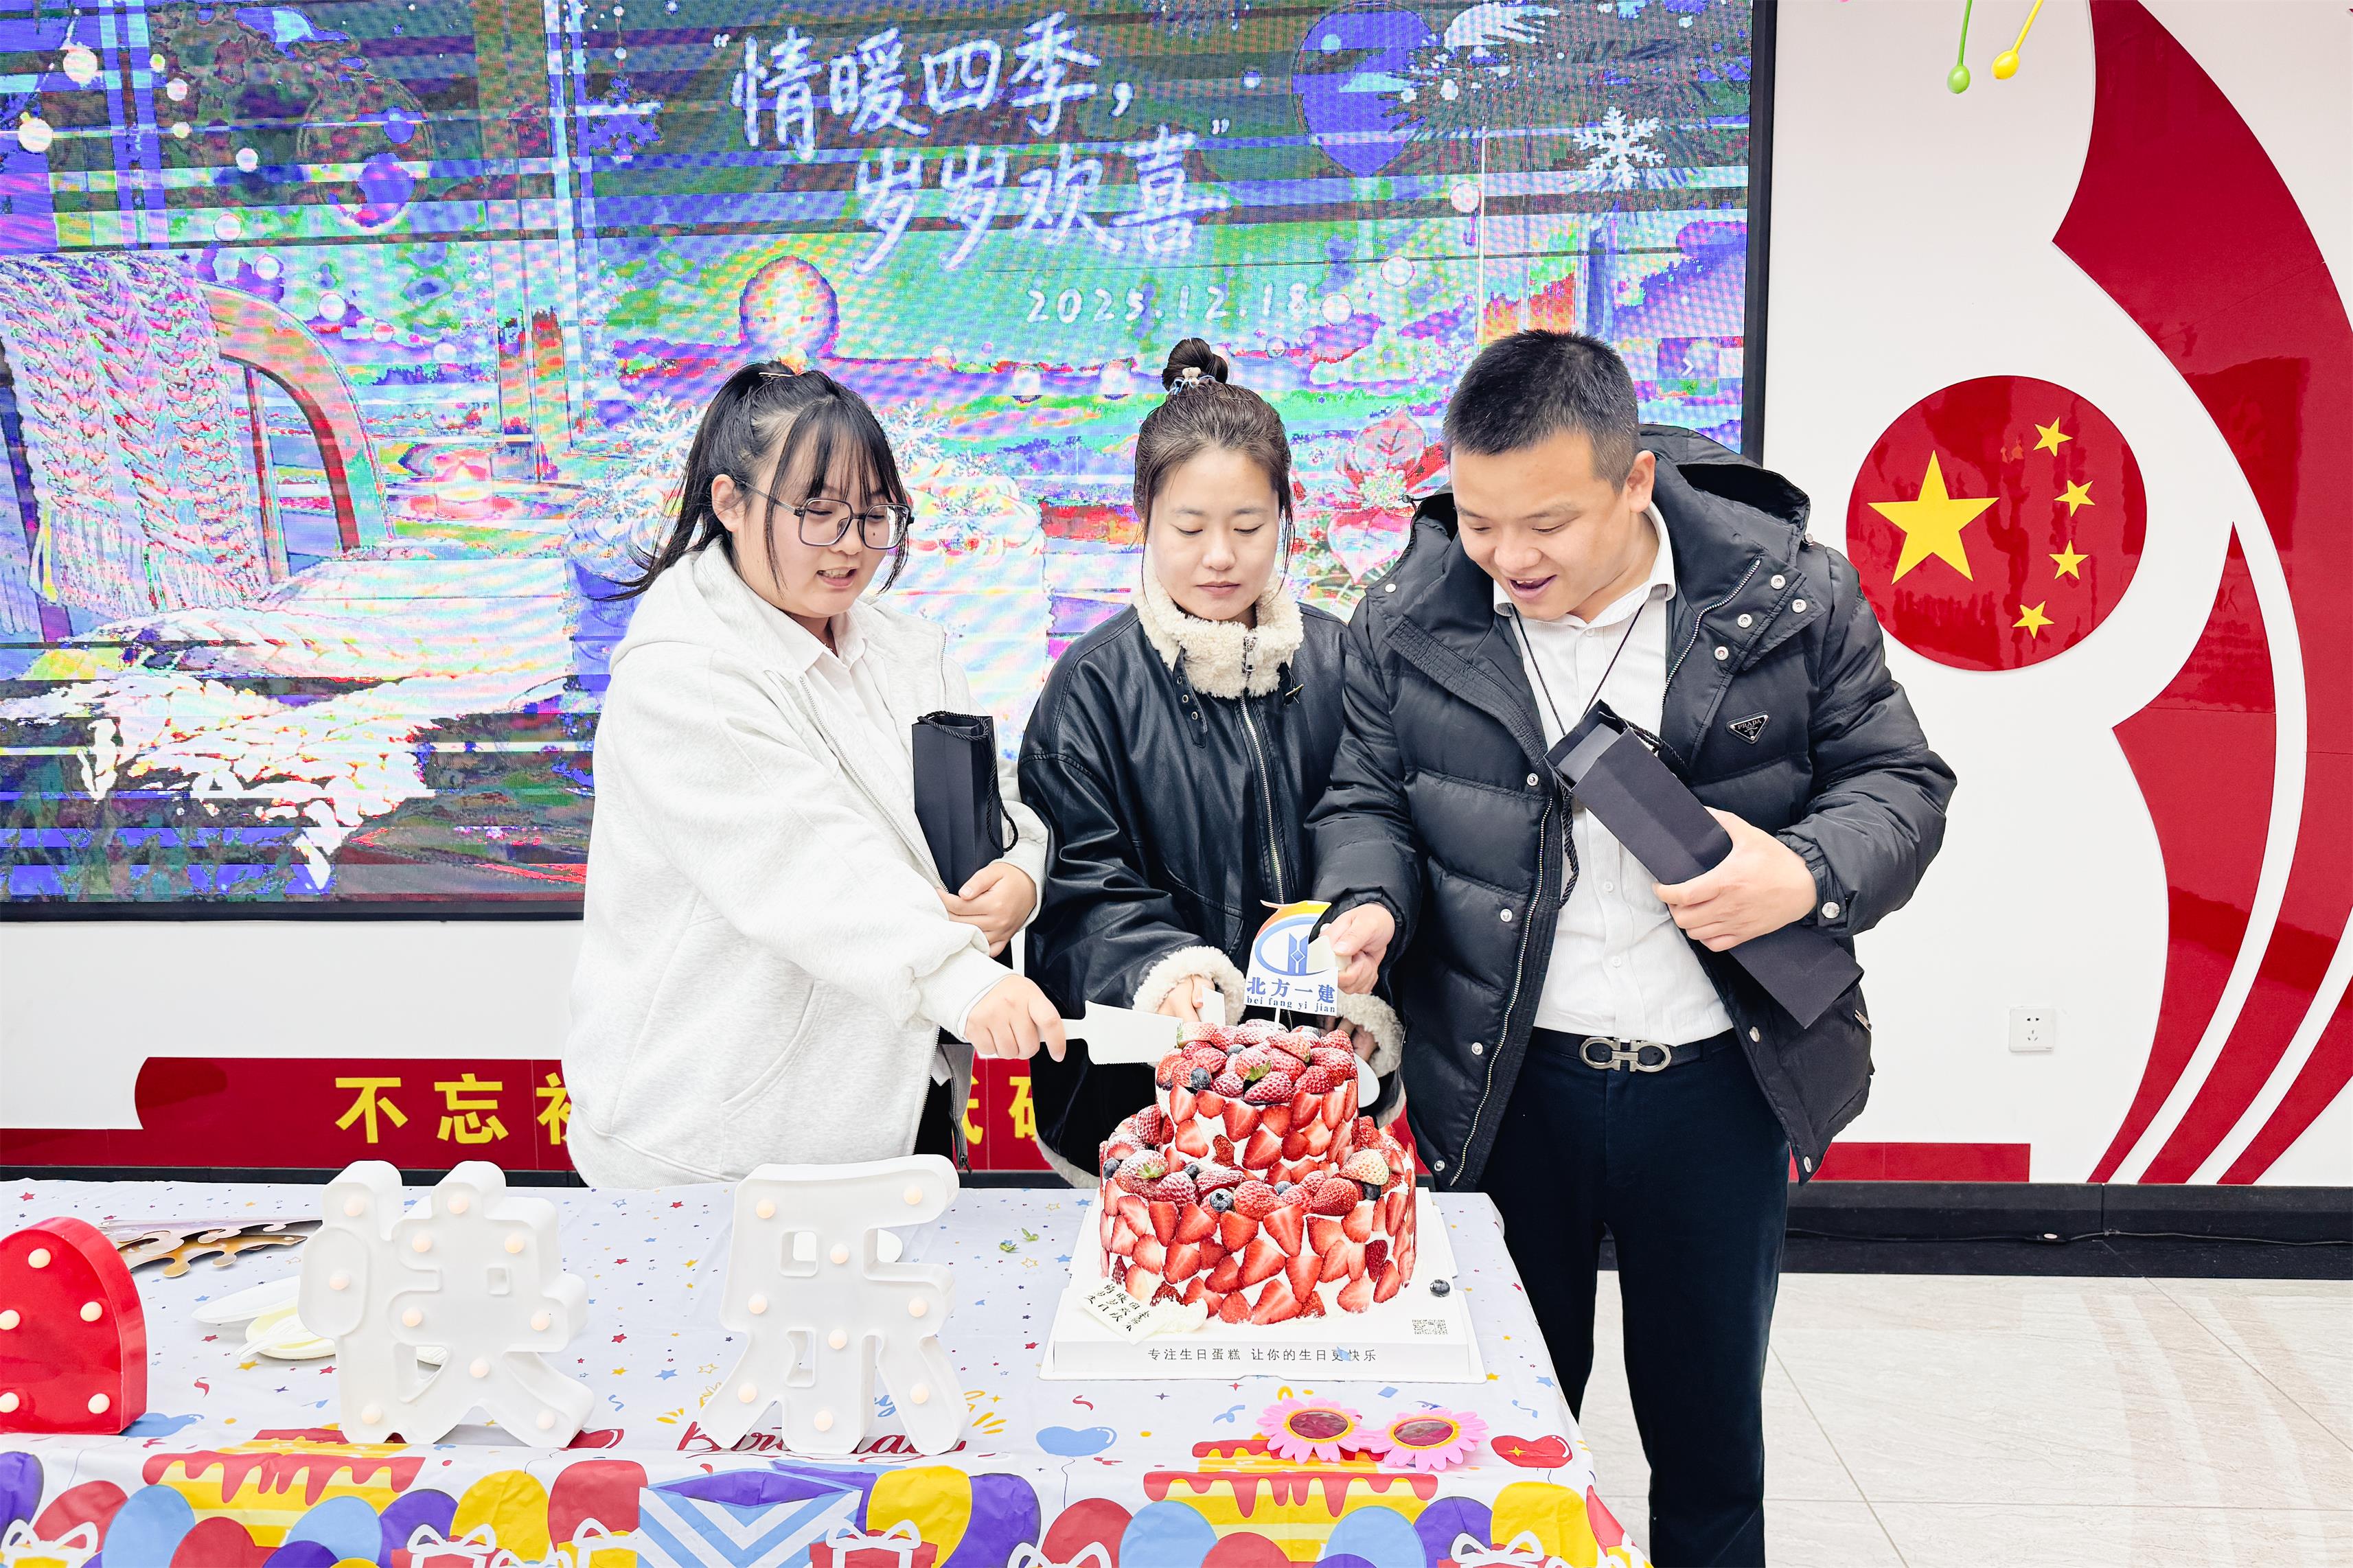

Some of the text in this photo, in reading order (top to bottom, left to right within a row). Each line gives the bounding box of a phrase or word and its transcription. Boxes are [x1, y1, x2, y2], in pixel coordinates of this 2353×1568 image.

[1026, 283, 1309, 324] 2025.12.18
[1738, 719, 1762, 730] PRADA
[1247, 977, 1335, 1003] 北方一建
[1247, 995, 1335, 1013] bei fang yi jian
[1147, 1348, 1377, 1361] 专注生日蛋糕 让你的生日更快乐
